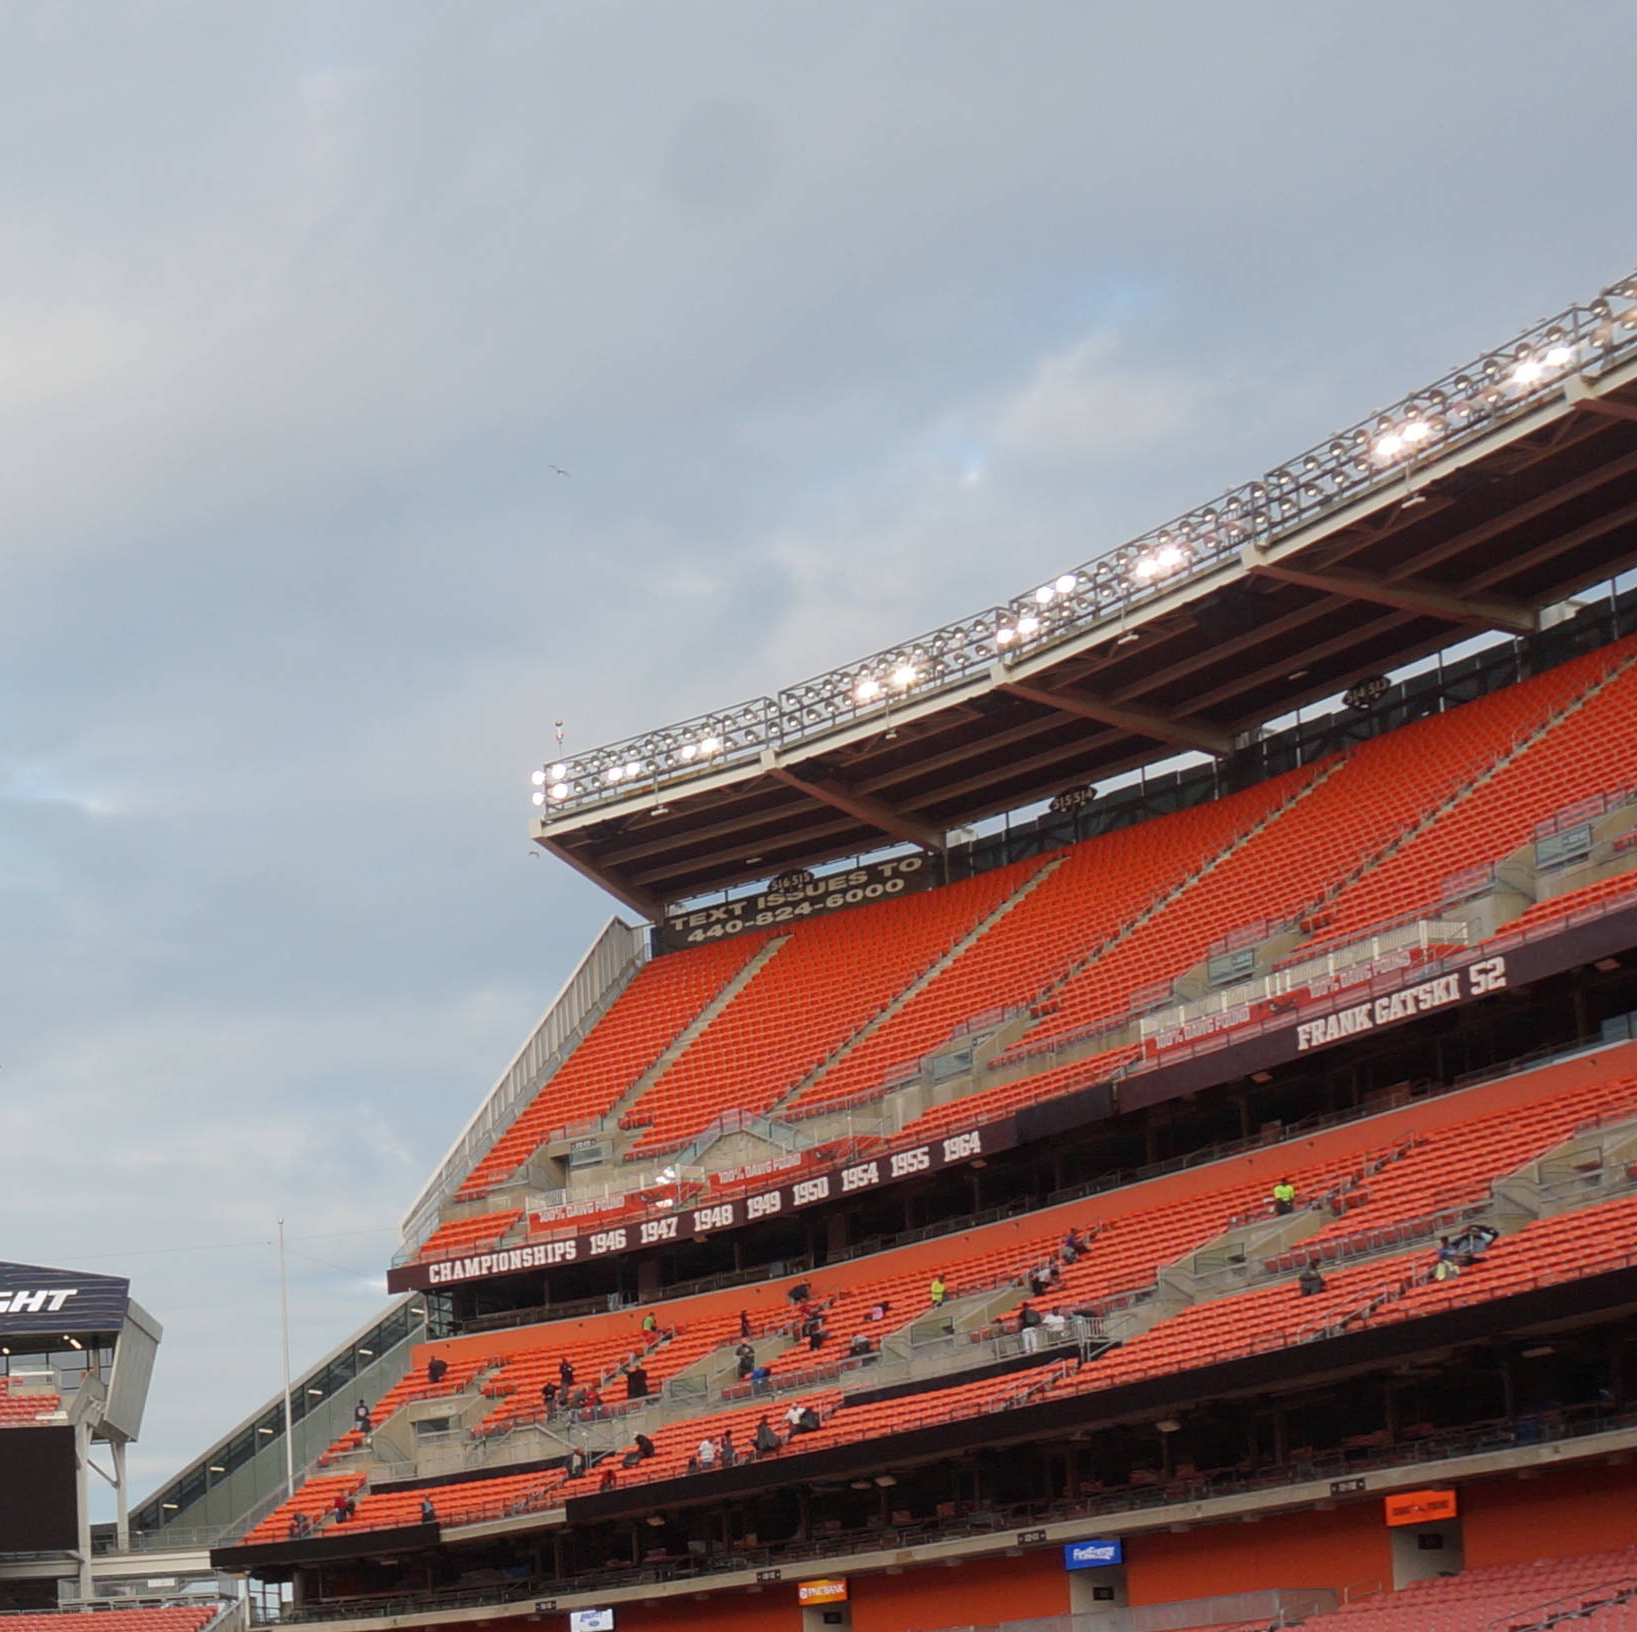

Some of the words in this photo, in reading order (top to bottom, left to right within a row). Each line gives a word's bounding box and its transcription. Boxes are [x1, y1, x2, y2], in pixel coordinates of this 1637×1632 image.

[670, 902, 747, 931] TEXT
[758, 871, 868, 909] ISSUES
[878, 857, 922, 877] TO
[687, 879, 904, 942] 440-824-6000
[1297, 1003, 1373, 1050] FRANK
[1375, 973, 1461, 1024] GATSKI
[1469, 956, 1507, 995] 52
[429, 1240, 577, 1283] CHAMPIONSHIPS
[589, 1229, 627, 1254] 1946
[640, 1217, 678, 1244] 1947
[693, 1204, 734, 1231] 1948
[747, 1191, 781, 1219] 1949
[793, 1177, 829, 1206] 1950
[842, 1162, 879, 1191] 1954
[891, 1147, 929, 1177] 1955
[943, 1131, 981, 1162] 1964
[718, 1167, 744, 1183] 100%
[745, 1161, 772, 1178] DAWG
